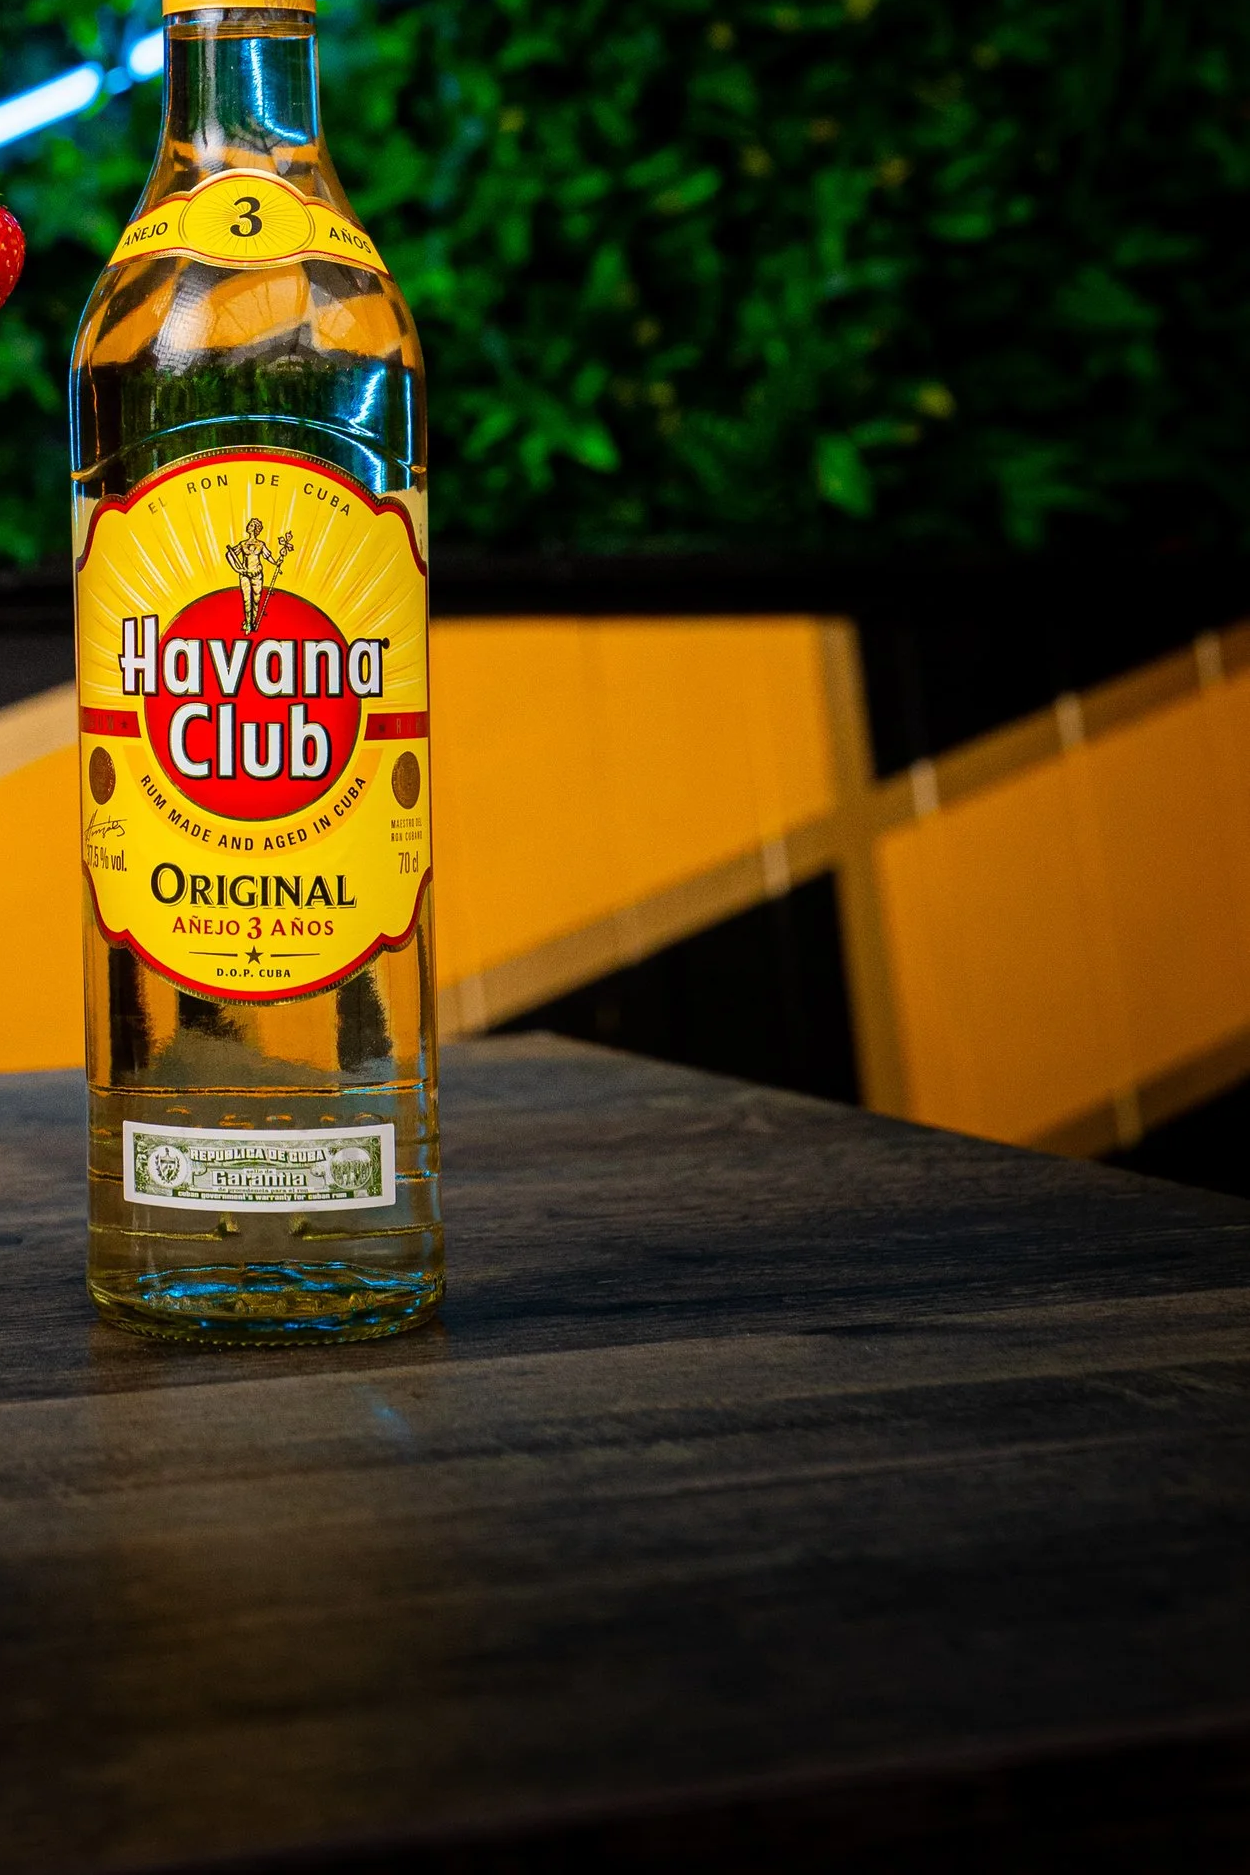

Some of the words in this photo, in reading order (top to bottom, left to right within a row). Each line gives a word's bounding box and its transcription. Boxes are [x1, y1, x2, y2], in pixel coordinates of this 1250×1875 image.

[123, 222, 168, 247] AÑEJO
[229, 196, 263, 238] 3
[328, 226, 372, 255] AÑOS
[148, 497, 168, 515] EL
[187, 474, 228, 495] RON
[255, 473, 280, 487] DE
[303, 482, 352, 516] CUBA
[118, 613, 384, 698] Havana
[167, 702, 333, 781] Club
[140, 775, 167, 810] RUM
[167, 808, 212, 843] MADE
[218, 835, 254, 851] AND
[263, 828, 308, 851] AGED
[313, 816, 332, 834] IN
[333, 777, 366, 817] CUBA
[111, 849, 127, 872] vol.
[398, 851, 410, 874] 70
[412, 850, 419, 873] cl
[150, 862, 357, 910] ORIGINAL
[172, 915, 241, 936] AÑEJO
[247, 916, 263, 940] 3
[270, 917, 334, 936] AÑOS
[216, 968, 254, 978] D.O.P.
[258, 968, 291, 978] CUBA
[189, 1148, 266, 1163] REPUBLICA
[268, 1149, 288, 1163] DE
[289, 1149, 327, 1163] CUBA
